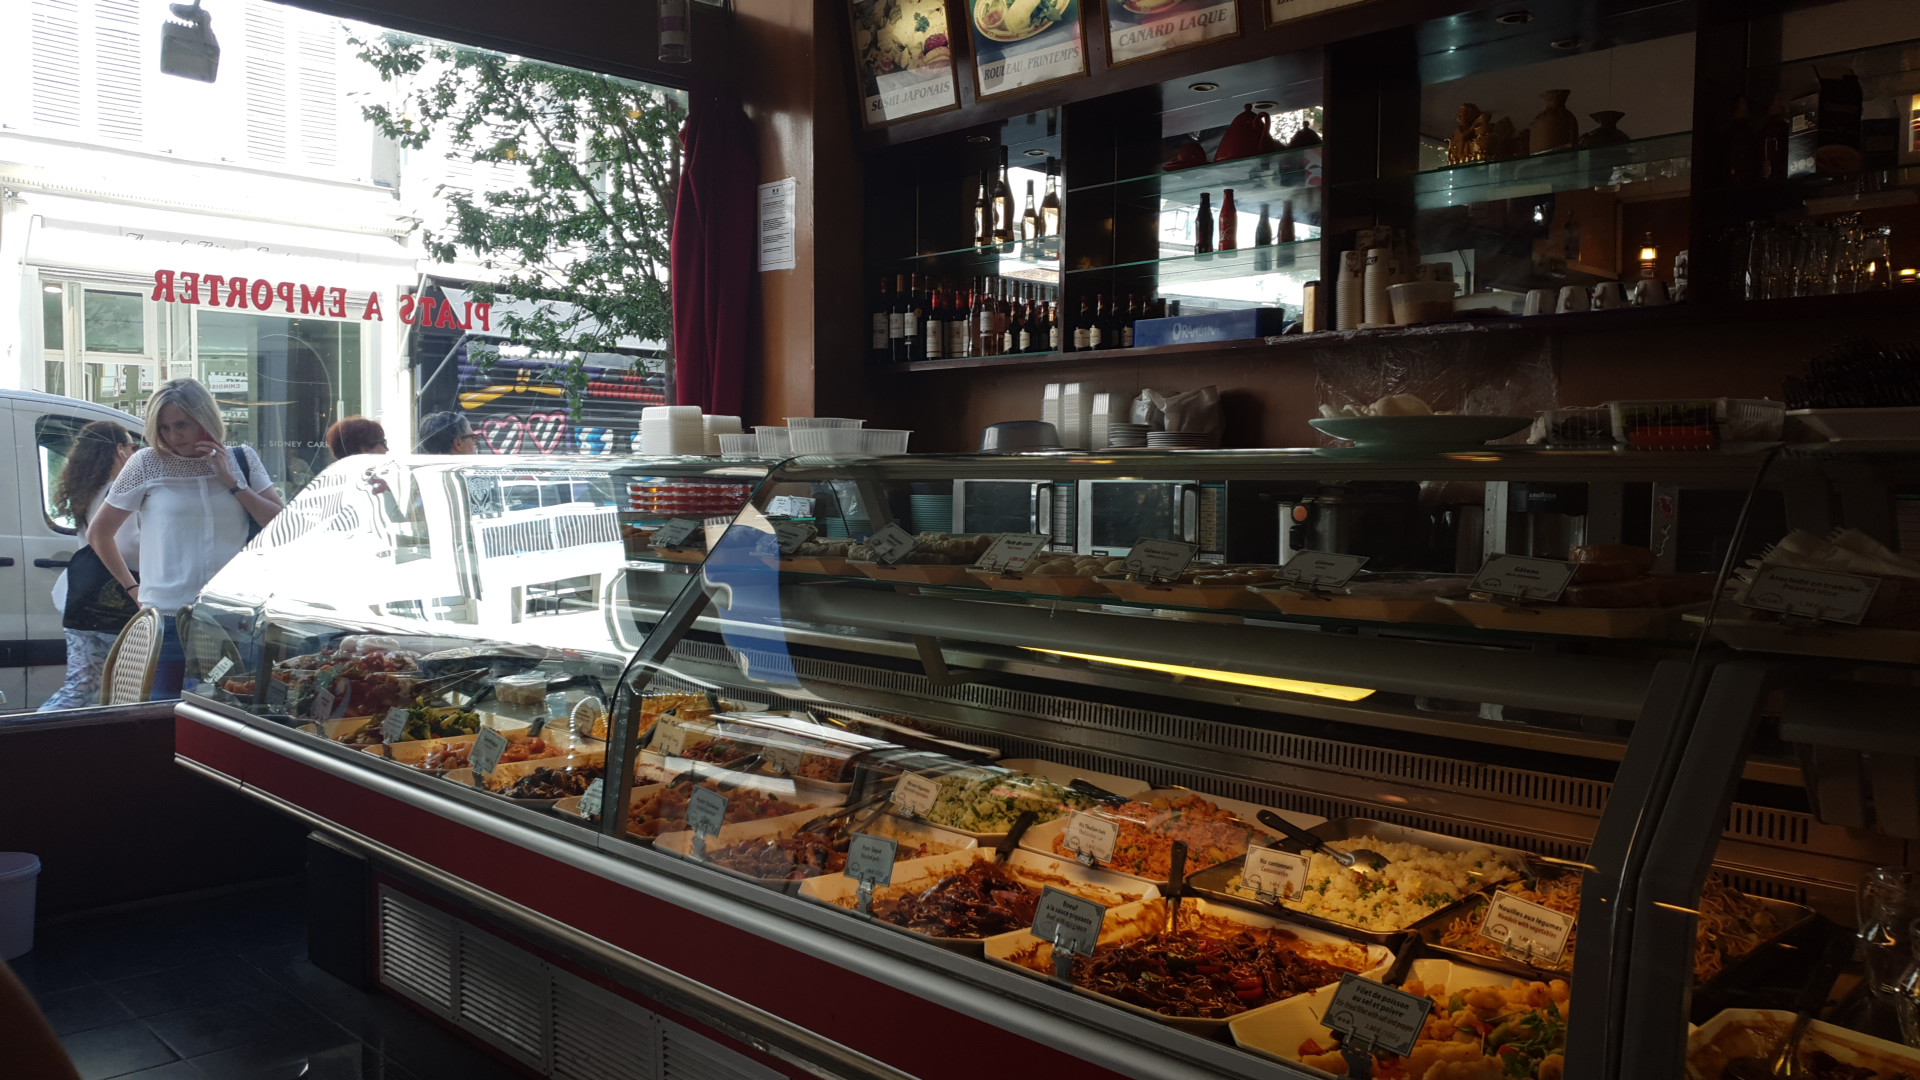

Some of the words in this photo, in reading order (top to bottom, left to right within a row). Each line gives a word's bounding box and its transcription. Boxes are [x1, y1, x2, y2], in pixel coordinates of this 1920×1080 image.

[1118, 23, 1175, 47] CANARD
[1179, 8, 1228, 31] LAQUE
[983, 61, 1023, 81] ROULEAU
[1027, 46, 1080, 69] PRINTEMPS
[871, 94, 900, 112] SUSHI
[901, 81, 951, 105] JAPONAIS
[268, 440, 302, 448] SIDNEY
[1055, 907, 1068, 916] sauce
[1069, 913, 1091, 925] piquante
[1498, 904, 1522, 916] Nouilles
[1536, 918, 1562, 932] légumes
[1355, 985, 1372, 996] Filet
[1371, 991, 1382, 999] de
[1382, 995, 1409, 1009] poisson
[1361, 997, 1372, 1005] sel
[1380, 1005, 1403, 1017] poivre
